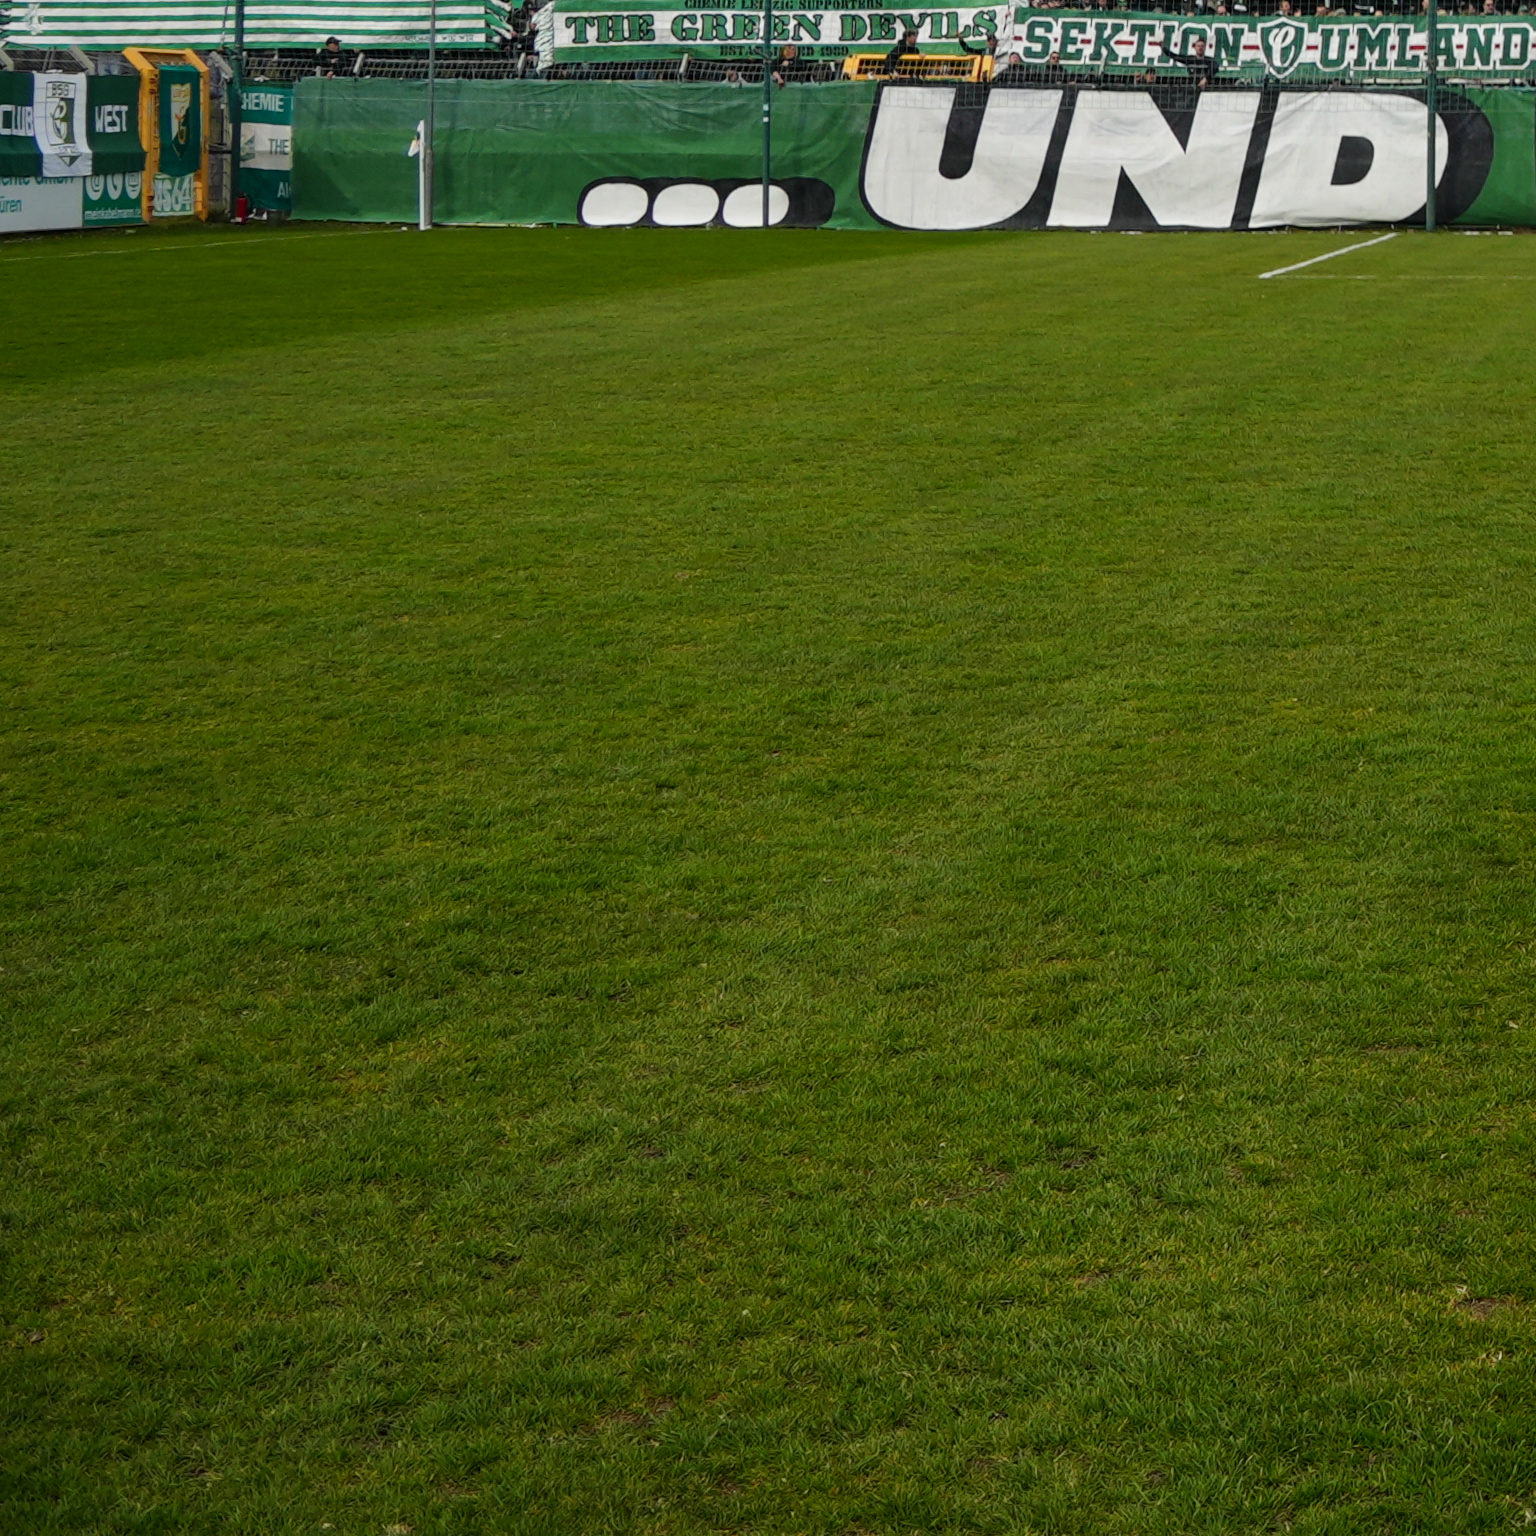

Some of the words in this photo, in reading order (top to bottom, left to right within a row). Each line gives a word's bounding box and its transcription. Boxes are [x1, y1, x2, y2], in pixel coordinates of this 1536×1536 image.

[565, 14, 656, 45] THE
[671, 13, 824, 43] GREEN
[839, 10, 998, 41] DEVILS
[819, 45, 850, 57] 1989
[1024, 18, 1246, 68] SEKTION
[1317, 23, 1533, 70] UMLAND
[51, 83, 70, 96] BSG
[241, 92, 285, 113] HEMIE
[0, 105, 34, 137] CLUB
[95, 104, 129, 134] WEST
[268, 138, 290, 157] THE
[862, 85, 1449, 231] UND
